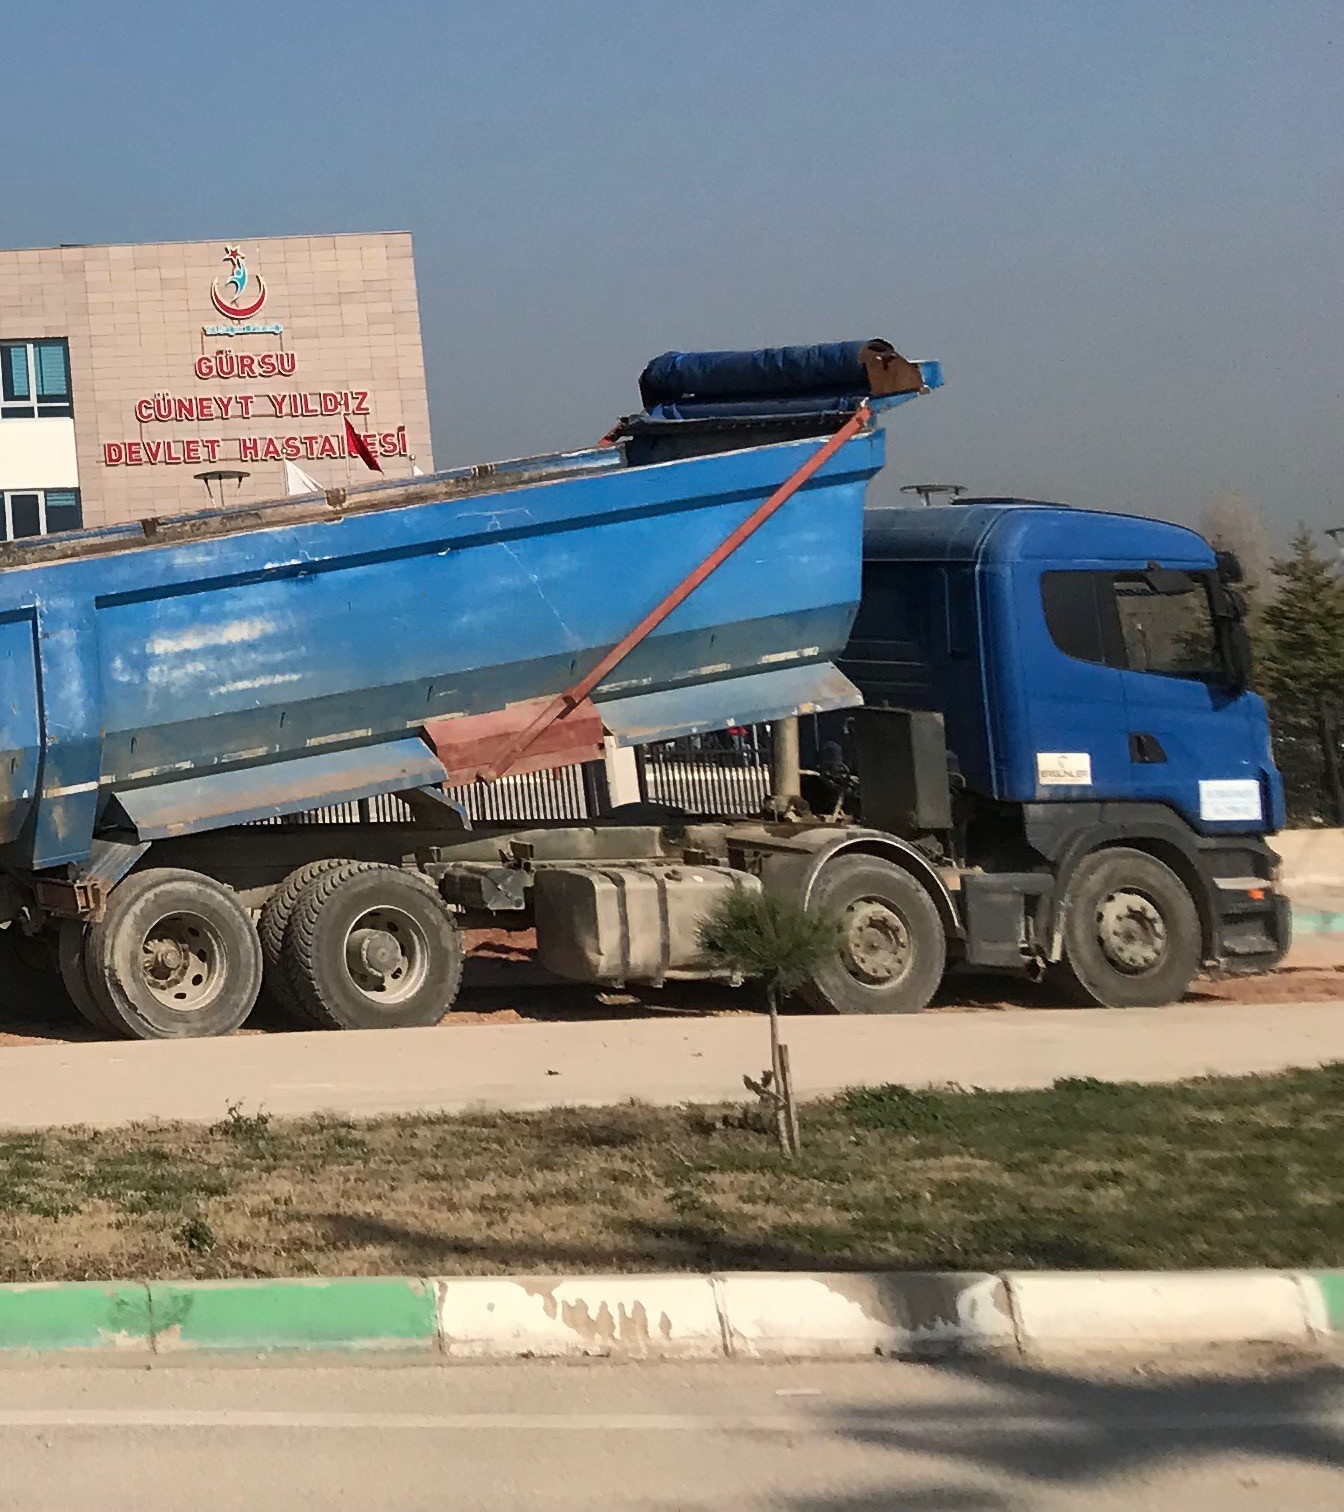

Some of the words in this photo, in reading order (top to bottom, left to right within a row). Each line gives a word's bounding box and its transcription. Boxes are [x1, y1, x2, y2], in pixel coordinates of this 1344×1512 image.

[196, 348, 297, 379] GÜRSU
[136, 391, 254, 421] CÜNEYT
[270, 391, 370, 417] YILDIZ
[104, 438, 220, 466] DEVLET
